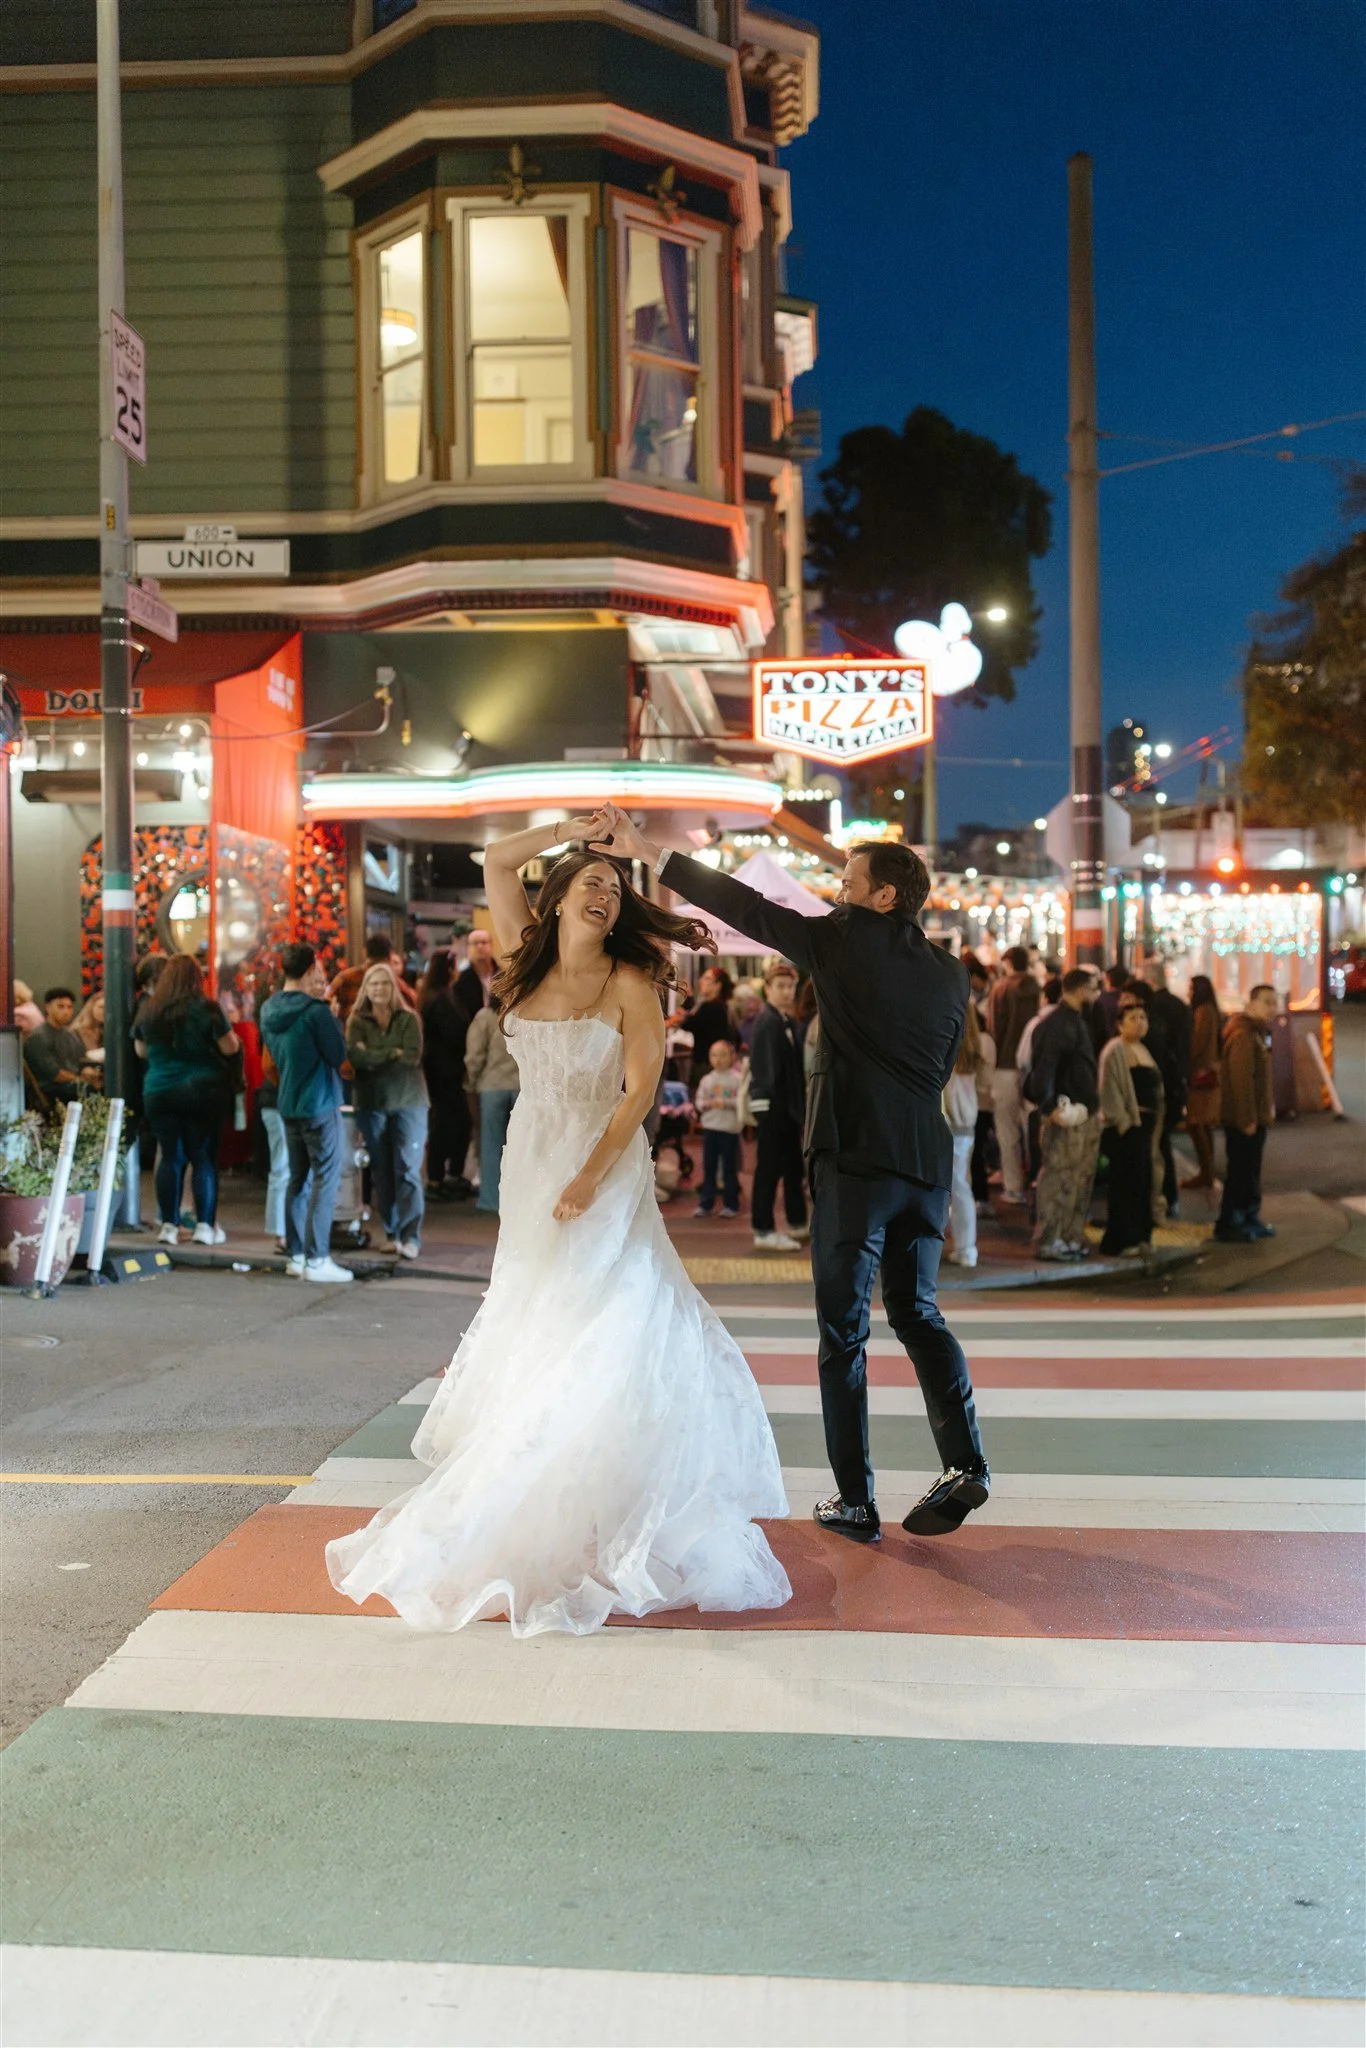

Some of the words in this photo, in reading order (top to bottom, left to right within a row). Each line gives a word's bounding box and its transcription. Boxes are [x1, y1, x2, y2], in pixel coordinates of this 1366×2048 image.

[114, 328, 142, 368] SPEED
[116, 385, 142, 445] 25
[167, 550, 254, 568] UNION
[762, 669, 925, 693] TONY'S
[45, 689, 144, 714] DOLI
[769, 697, 916, 732] PIZZA
